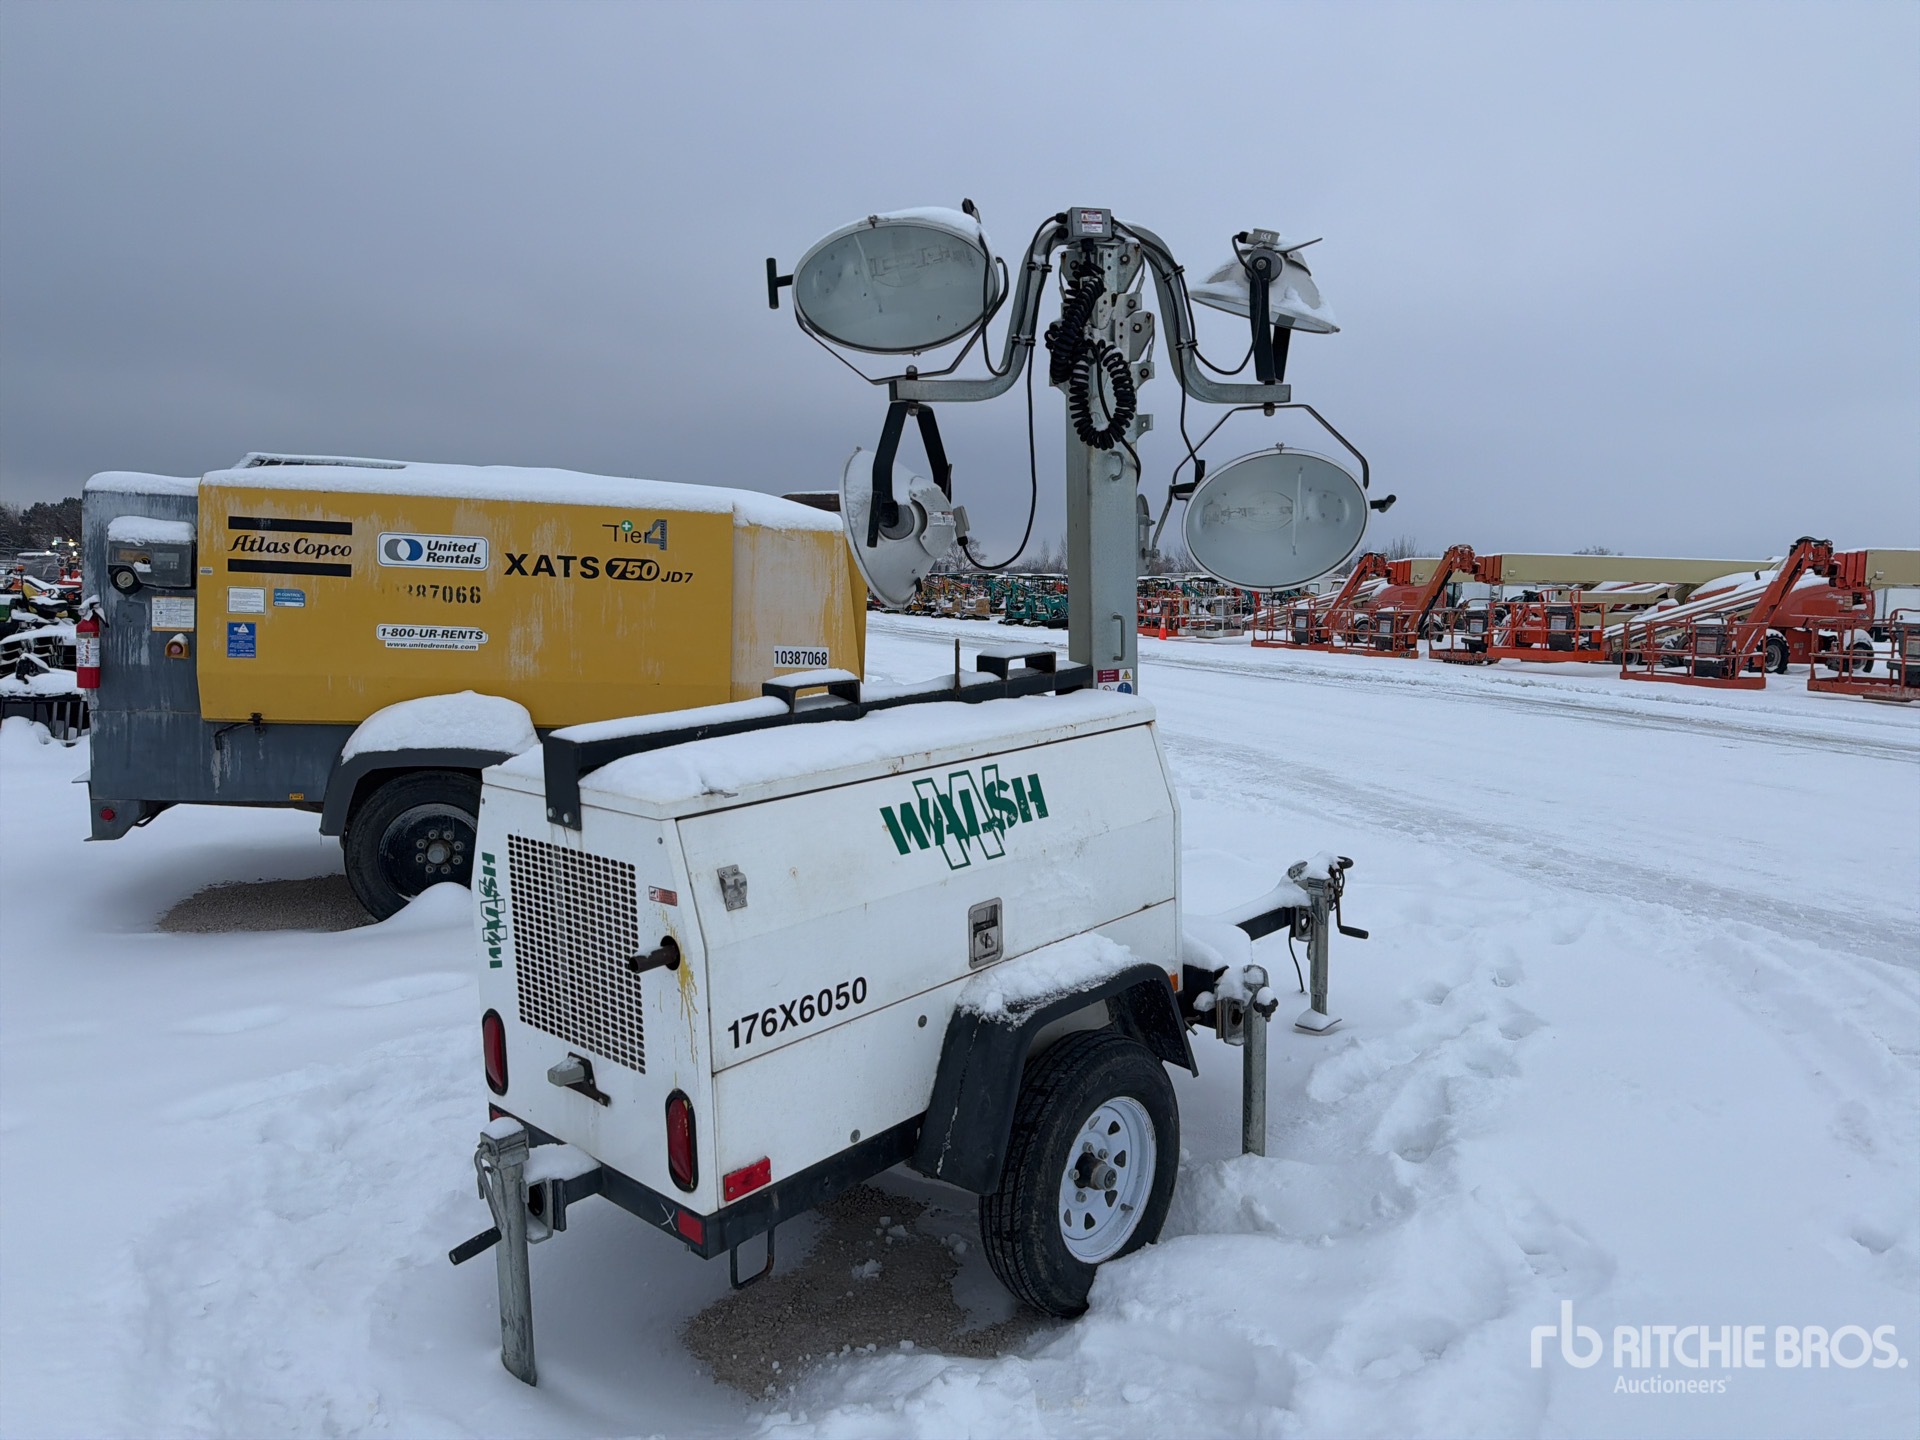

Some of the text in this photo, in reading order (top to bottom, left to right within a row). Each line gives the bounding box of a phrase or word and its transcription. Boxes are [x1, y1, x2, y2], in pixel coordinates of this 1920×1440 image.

[602, 523, 651, 544] Tier
[228, 535, 352, 559] Atlas Copco
[426, 540, 477, 553] United
[426, 552, 482, 565] Rentals
[503, 553, 694, 583] XATS 750 JD7
[380, 628, 484, 640] 1-800-UR-RENTS
[386, 641, 477, 650] www.unitedrentals.com
[774, 650, 828, 666] 10387068
[879, 772, 1049, 857] WALSH
[481, 851, 503, 969] WALSH
[727, 976, 867, 1049] 176X6050
